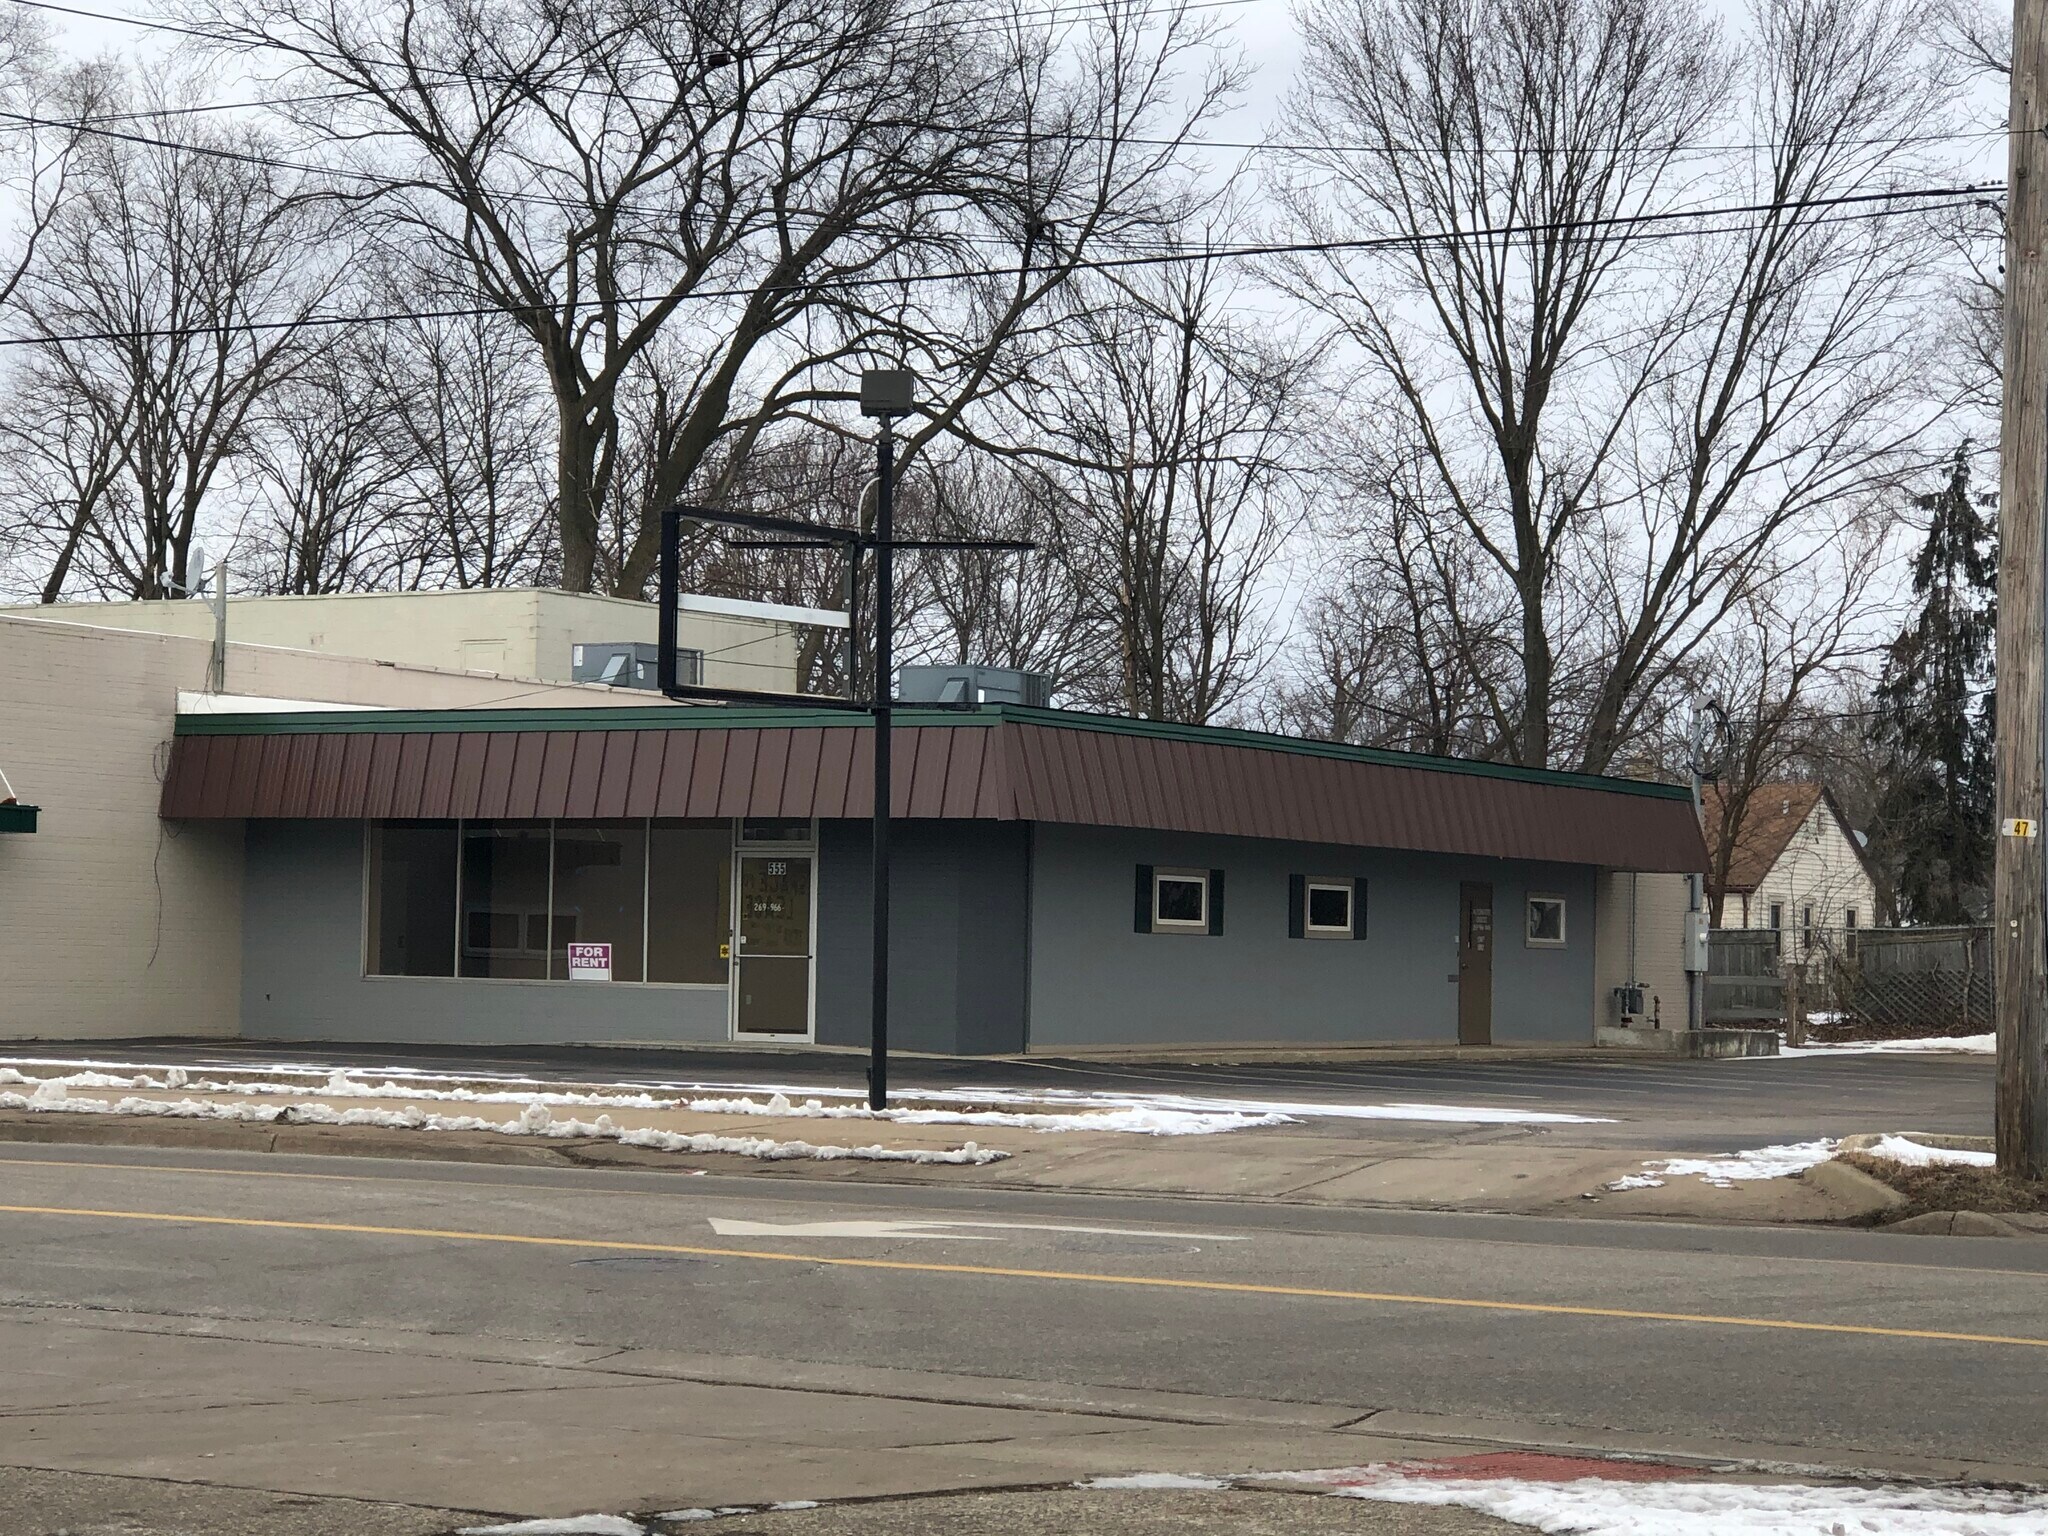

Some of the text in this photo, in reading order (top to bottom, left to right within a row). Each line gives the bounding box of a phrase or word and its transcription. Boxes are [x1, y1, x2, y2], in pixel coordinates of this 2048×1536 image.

[2014, 821, 2029, 836] 47
[768, 863, 786, 875] 555
[575, 947, 603, 957] FOR
[572, 957, 608, 968] RENT
